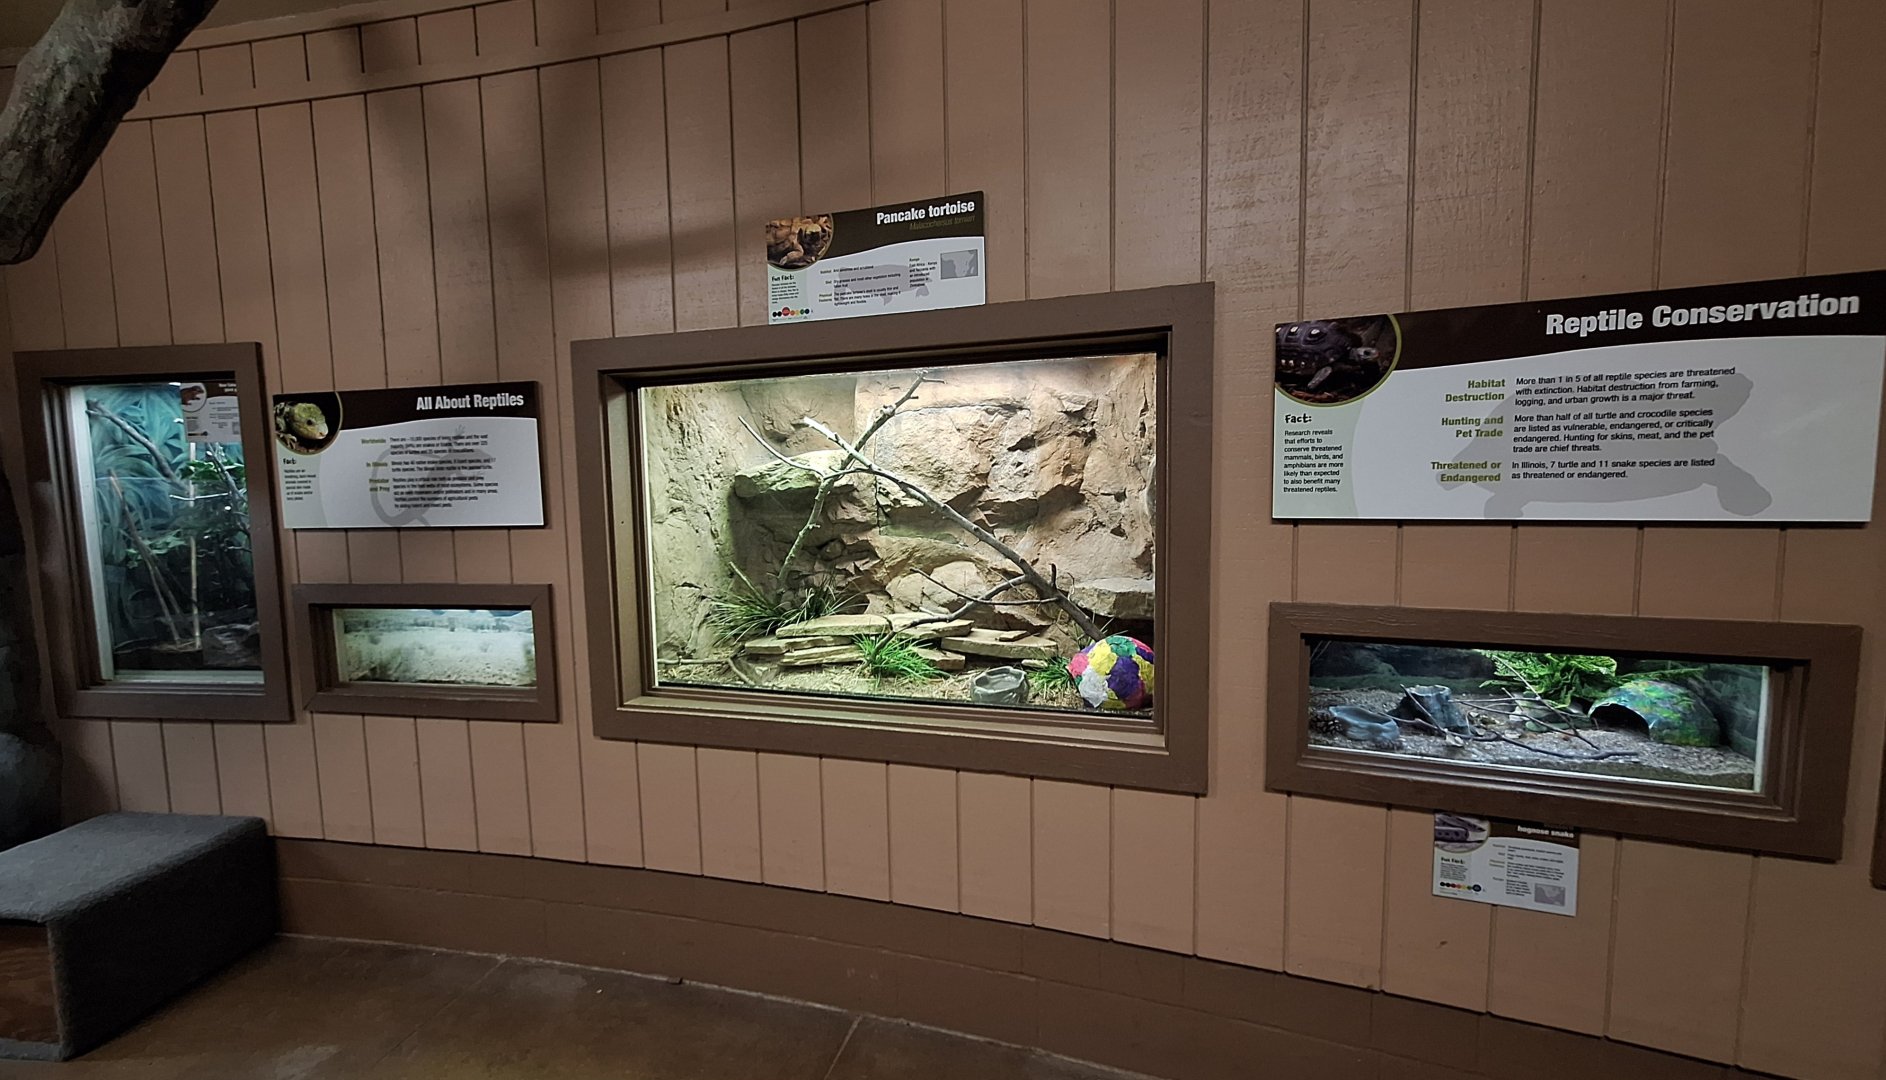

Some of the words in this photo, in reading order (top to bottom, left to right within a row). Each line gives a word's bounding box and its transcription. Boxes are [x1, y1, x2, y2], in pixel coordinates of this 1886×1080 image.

[876, 208, 926, 224] Pancake
[928, 201, 974, 218] tortoise
[1546, 308, 1643, 336] Reptile
[1652, 294, 1860, 328] Conservation
[1606, 373, 1632, 382] reptile
[1634, 371, 1667, 380] species
[1686, 367, 1736, 377] threatened
[1468, 379, 1506, 388] Habitat
[1534, 386, 1574, 395] extinction.
[1577, 384, 1606, 393] Habitat
[1608, 382, 1656, 391] destruction
[1682, 380, 1718, 388] farming,
[416, 398, 432, 410] All
[435, 394, 470, 410] About
[474, 393, 524, 411] Reptiles
[1446, 392, 1504, 402] Destruction
[1515, 398, 1546, 406] logging,
[1565, 396, 1588, 404] urban
[1590, 394, 1620, 404] growth
[1640, 393, 1664, 402] major
[1666, 391, 1695, 400] threat.
[1285, 413, 1312, 423] Fact:
[1637, 410, 1677, 418] crocodile
[1679, 408, 1713, 418] species
[1441, 416, 1481, 426] Hunting
[1484, 416, 1504, 424] and
[1563, 422, 1608, 432] vulnerable,
[1610, 421, 1662, 430] endangered,
[1676, 420, 1714, 428] critically
[1456, 429, 1472, 438] Pet
[1474, 428, 1504, 438] Trade
[1514, 434, 1562, 443] endangered.
[1564, 434, 1595, 442] Hunting
[1610, 432, 1636, 440] skins,
[1637, 432, 1662, 440] meat,
[1664, 431, 1680, 439] and
[1700, 430, 1714, 439] pet
[1550, 444, 1570, 452] chief
[1572, 444, 1602, 452] threats.
[1430, 460, 1488, 470] Threatened
[1521, 462, 1548, 470] Illinois,
[1558, 460, 1578, 468] turtle
[1598, 460, 1608, 468] 11
[1638, 459, 1672, 468] species
[1690, 458, 1715, 466] listed
[1440, 473, 1501, 484] Endangered
[1522, 471, 1565, 479] threatened
[1577, 470, 1628, 480] endangered.
[1518, 826, 1549, 836] hognose
[1551, 829, 1574, 838] snake
